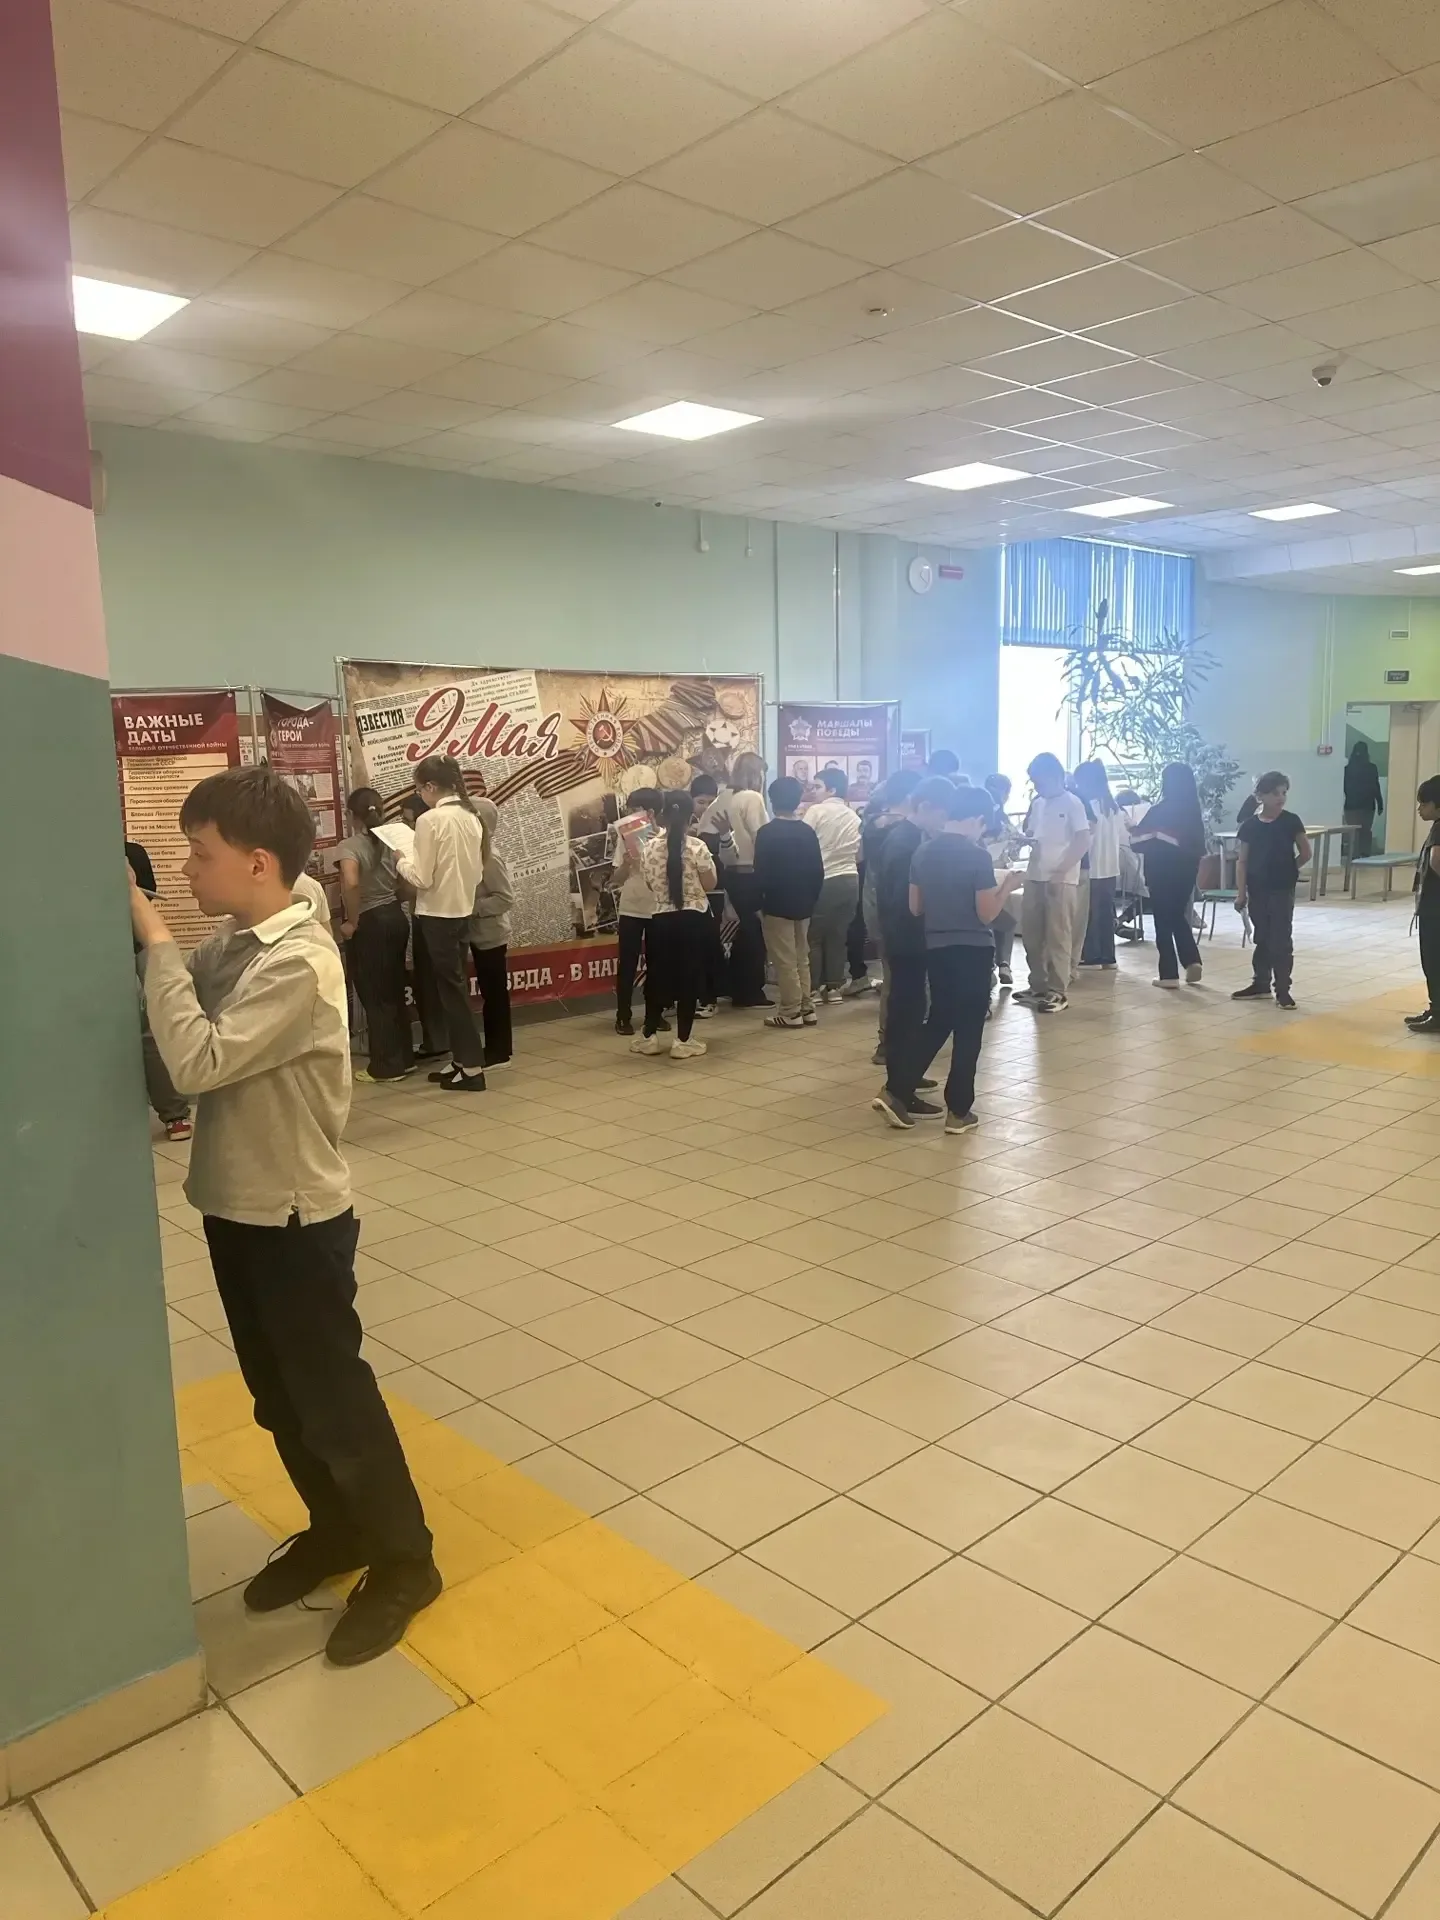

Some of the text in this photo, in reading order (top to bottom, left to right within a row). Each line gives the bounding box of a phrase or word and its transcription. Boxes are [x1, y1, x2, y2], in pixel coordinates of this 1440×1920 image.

[123, 713, 204, 729] ВАЖНЫЕ
[356, 708, 405, 732] ИЗВЕСТИЯ
[816, 719, 873, 729] МАРШАЛЫ
[127, 730, 177, 745] ДАТЫ
[277, 730, 303, 742] ГЕРОИ
[447, 703, 562, 759] Мая
[816, 728, 860, 738] ПОБЕДЫ
